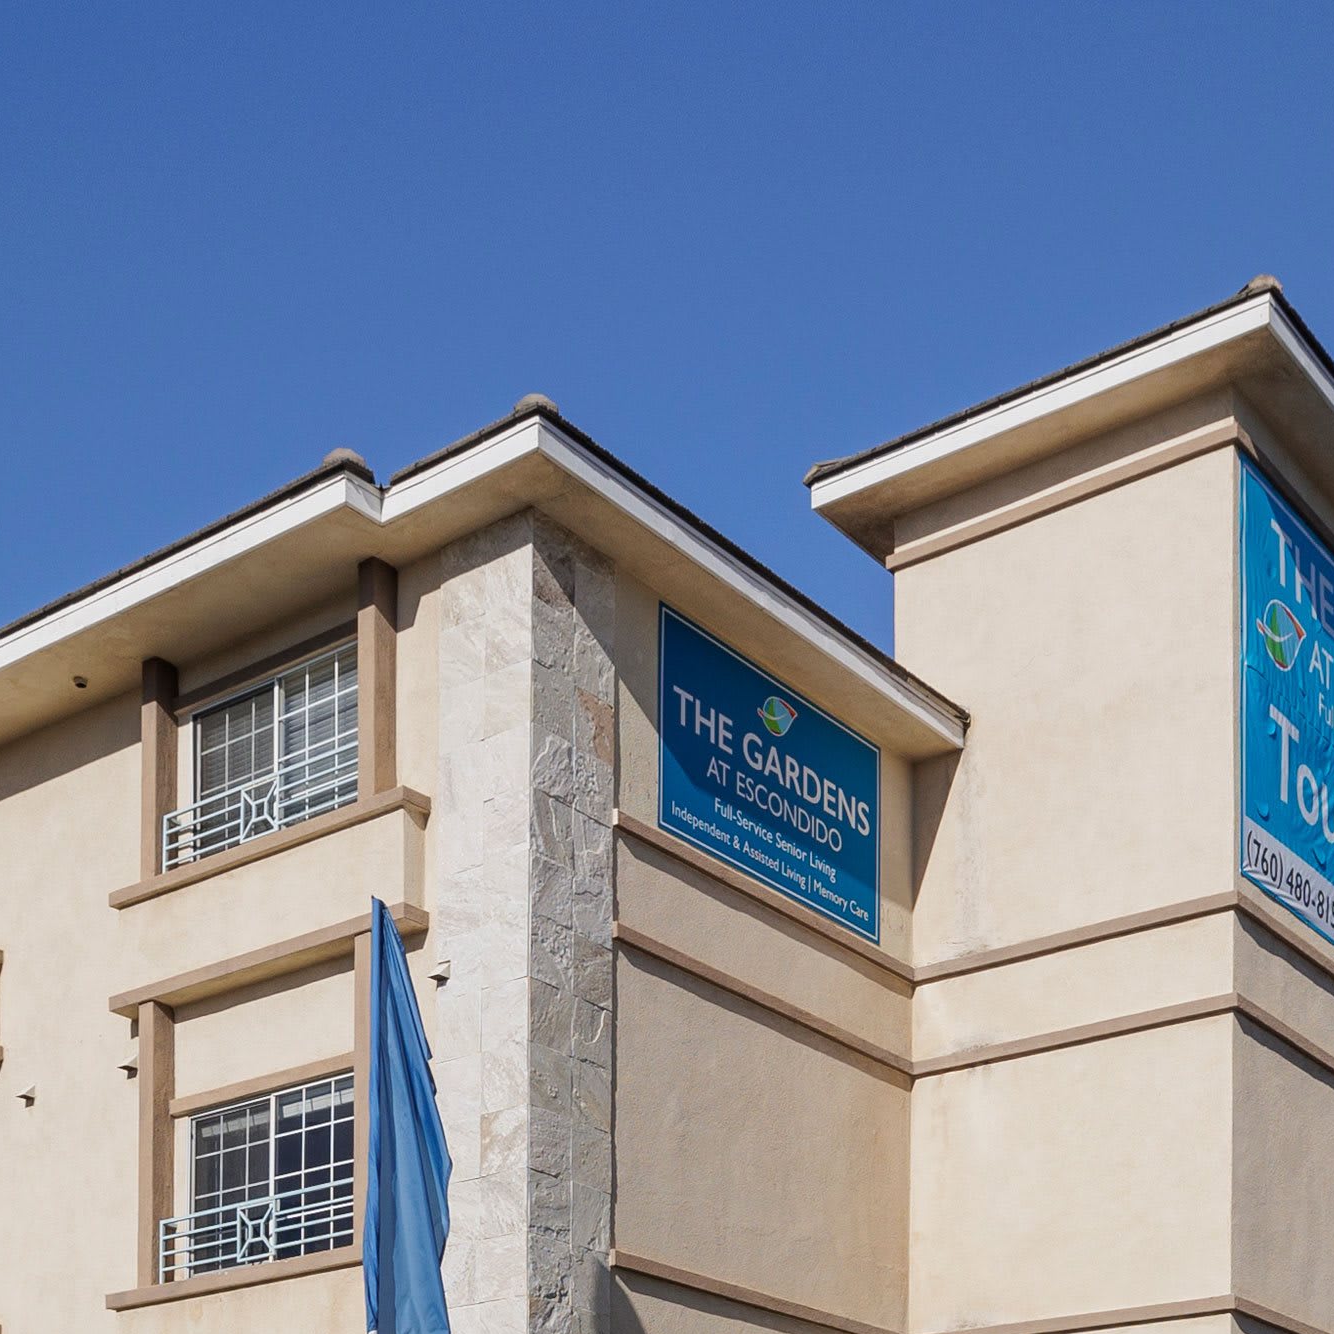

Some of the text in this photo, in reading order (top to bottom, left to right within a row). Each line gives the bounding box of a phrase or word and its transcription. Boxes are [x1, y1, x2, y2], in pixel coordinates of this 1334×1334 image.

[1309, 640, 1334, 690] AT
[673, 685, 870, 836] THE GARDENS
[706, 756, 842, 852] AT ESCONDIDO
[672, 801, 731, 845] Independent
[733, 835, 740, 850] &
[743, 841, 779, 872] Assisted
[782, 861, 806, 890] Living
[813, 879, 848, 912] Memory
[849, 900, 869, 921] Care
[714, 797, 836, 883] Full-Service Senior Living
[1247, 830, 1283, 889] (760)
